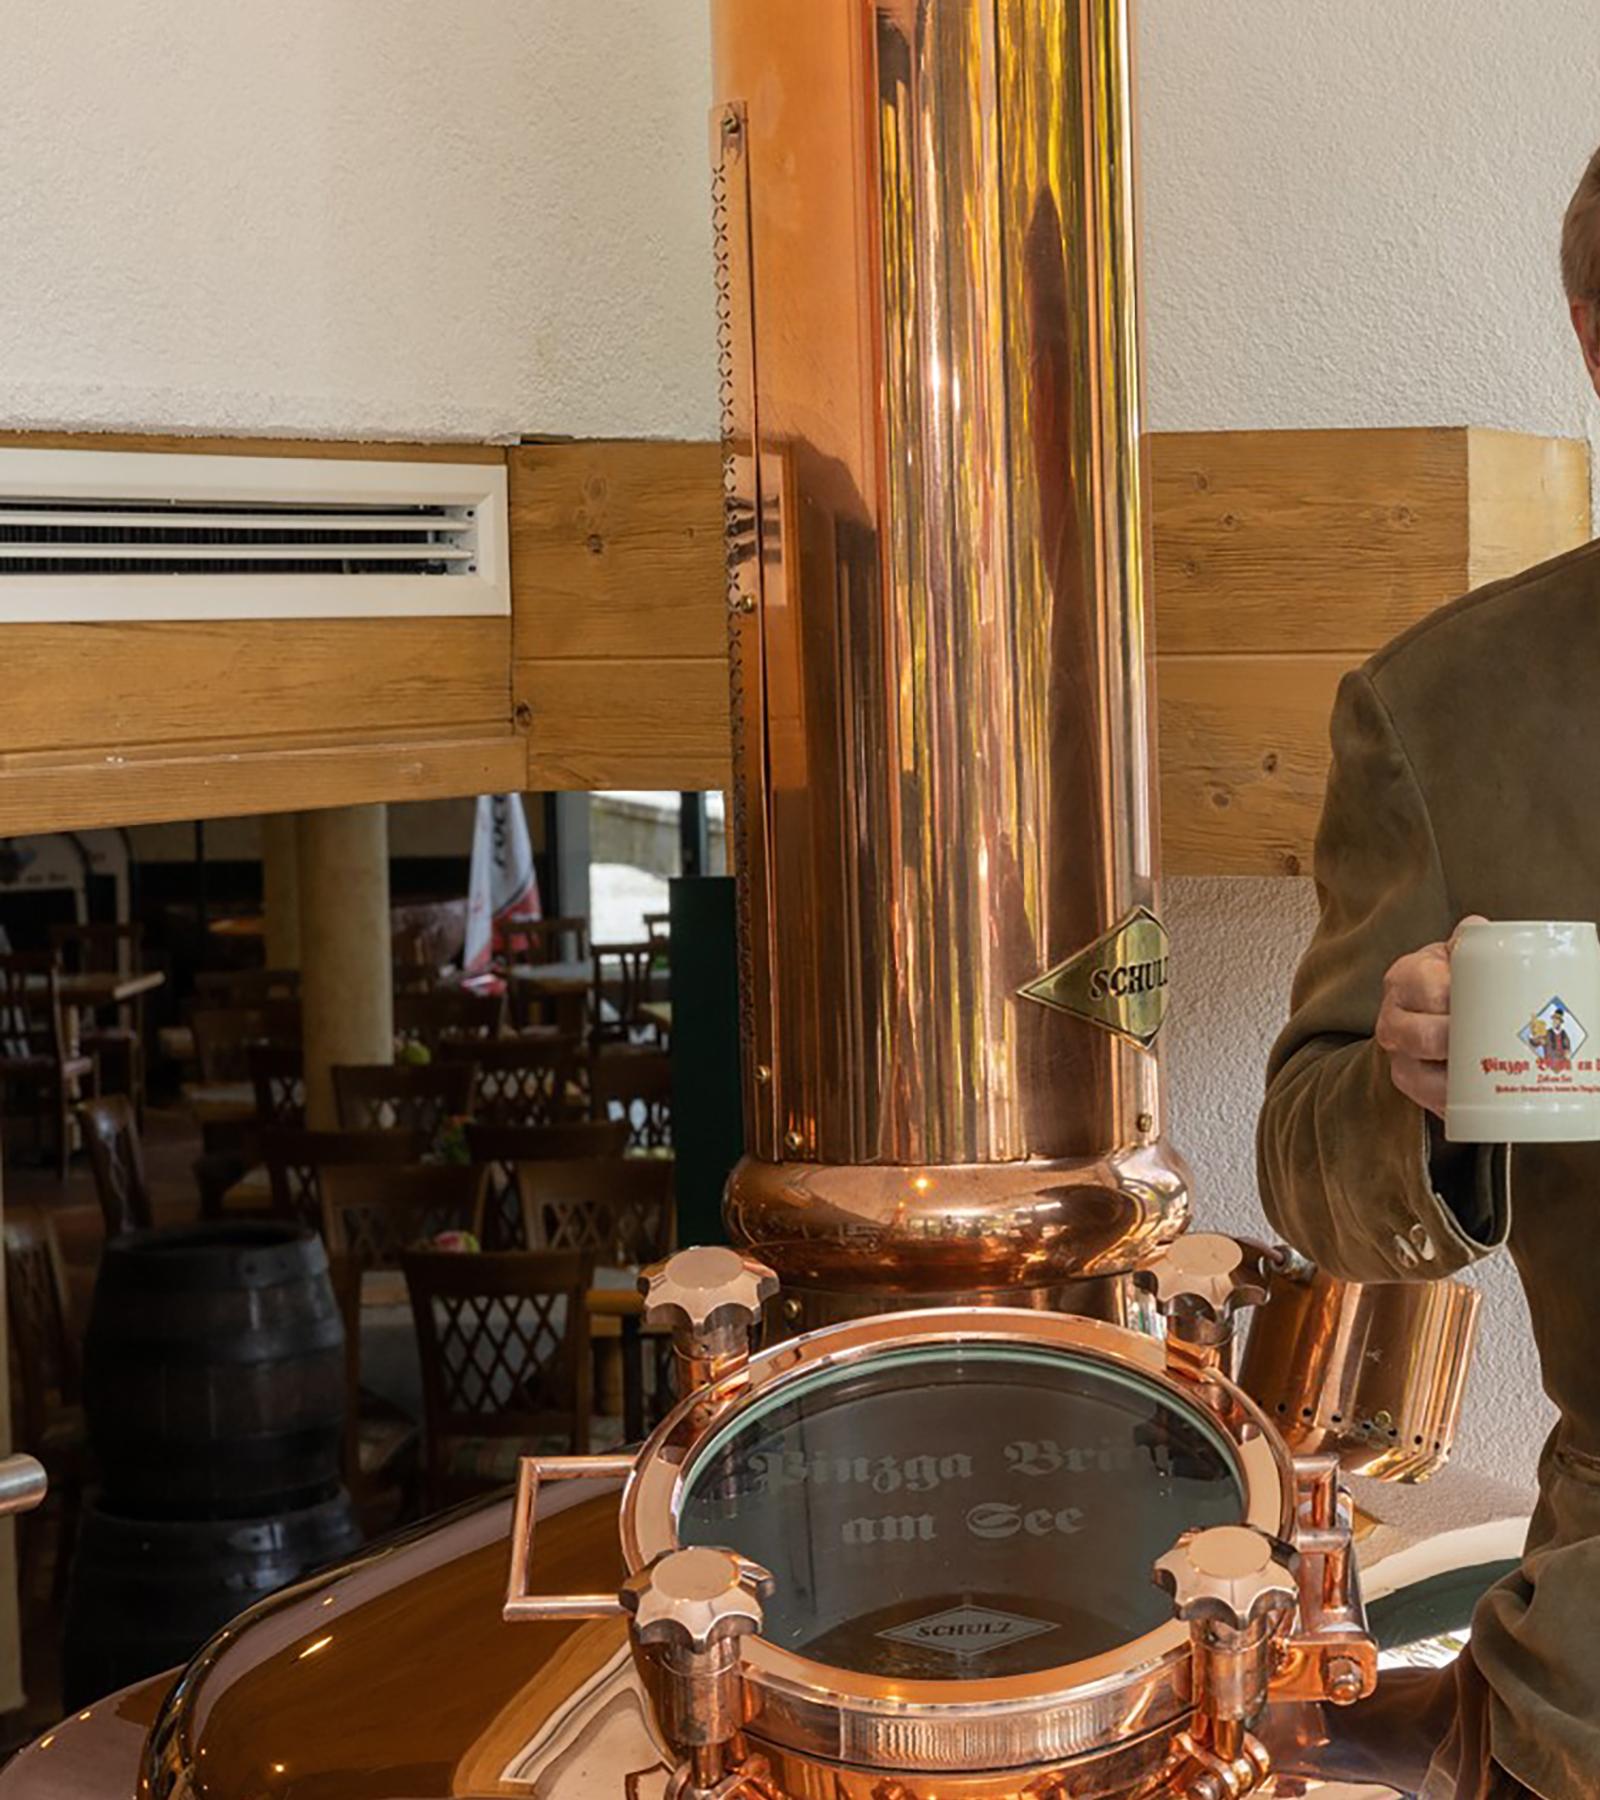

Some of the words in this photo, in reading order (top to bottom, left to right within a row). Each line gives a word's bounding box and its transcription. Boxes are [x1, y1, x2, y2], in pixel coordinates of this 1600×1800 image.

[747, 1449, 973, 1493] Pinzga
[1003, 1439, 1174, 1478] Bräu
[841, 1513, 938, 1546] am
[965, 1501, 1088, 1540] See
[916, 1620, 1014, 1640] SCHULZ
